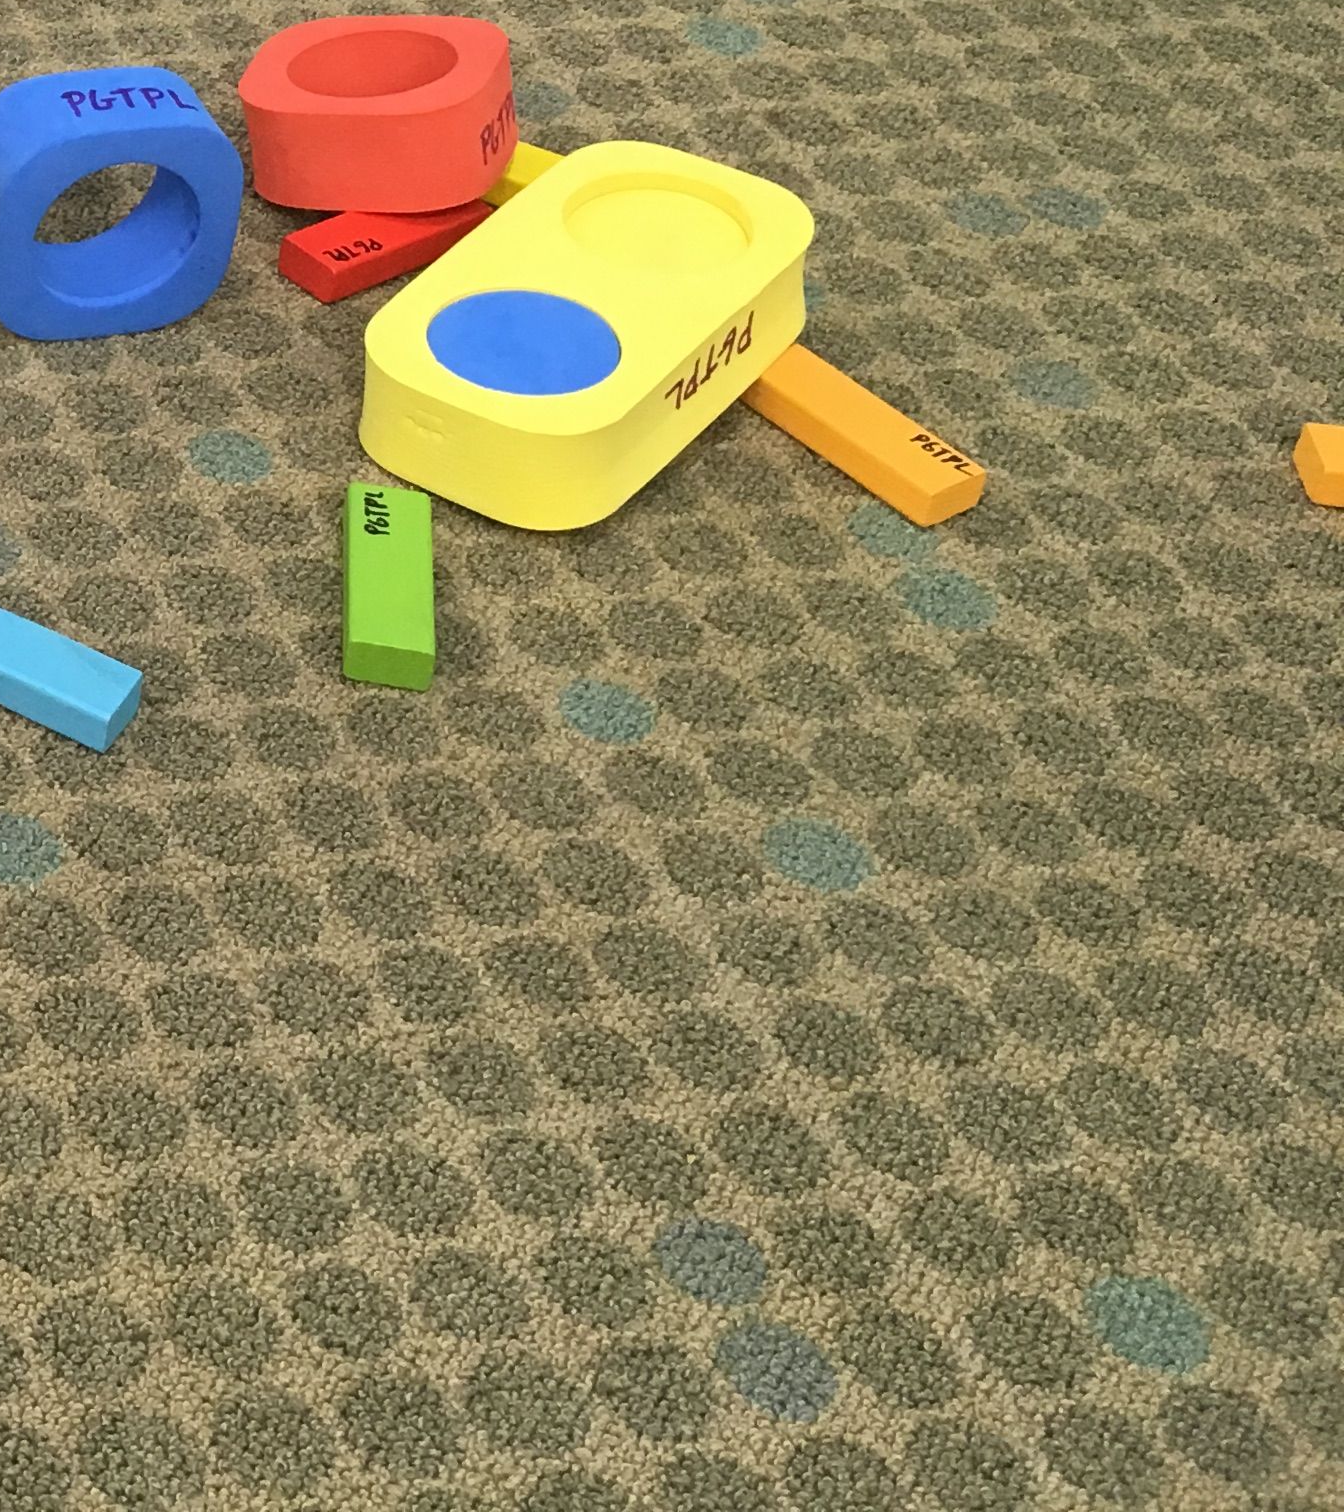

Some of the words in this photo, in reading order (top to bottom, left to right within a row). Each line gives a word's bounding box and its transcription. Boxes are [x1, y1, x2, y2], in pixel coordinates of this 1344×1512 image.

[60, 87, 199, 118] PGTPL
[322, 238, 384, 262] PGTPL
[664, 310, 754, 410] PGTPL
[909, 434, 975, 477] PGTPL
[364, 492, 391, 535] PGTPL
